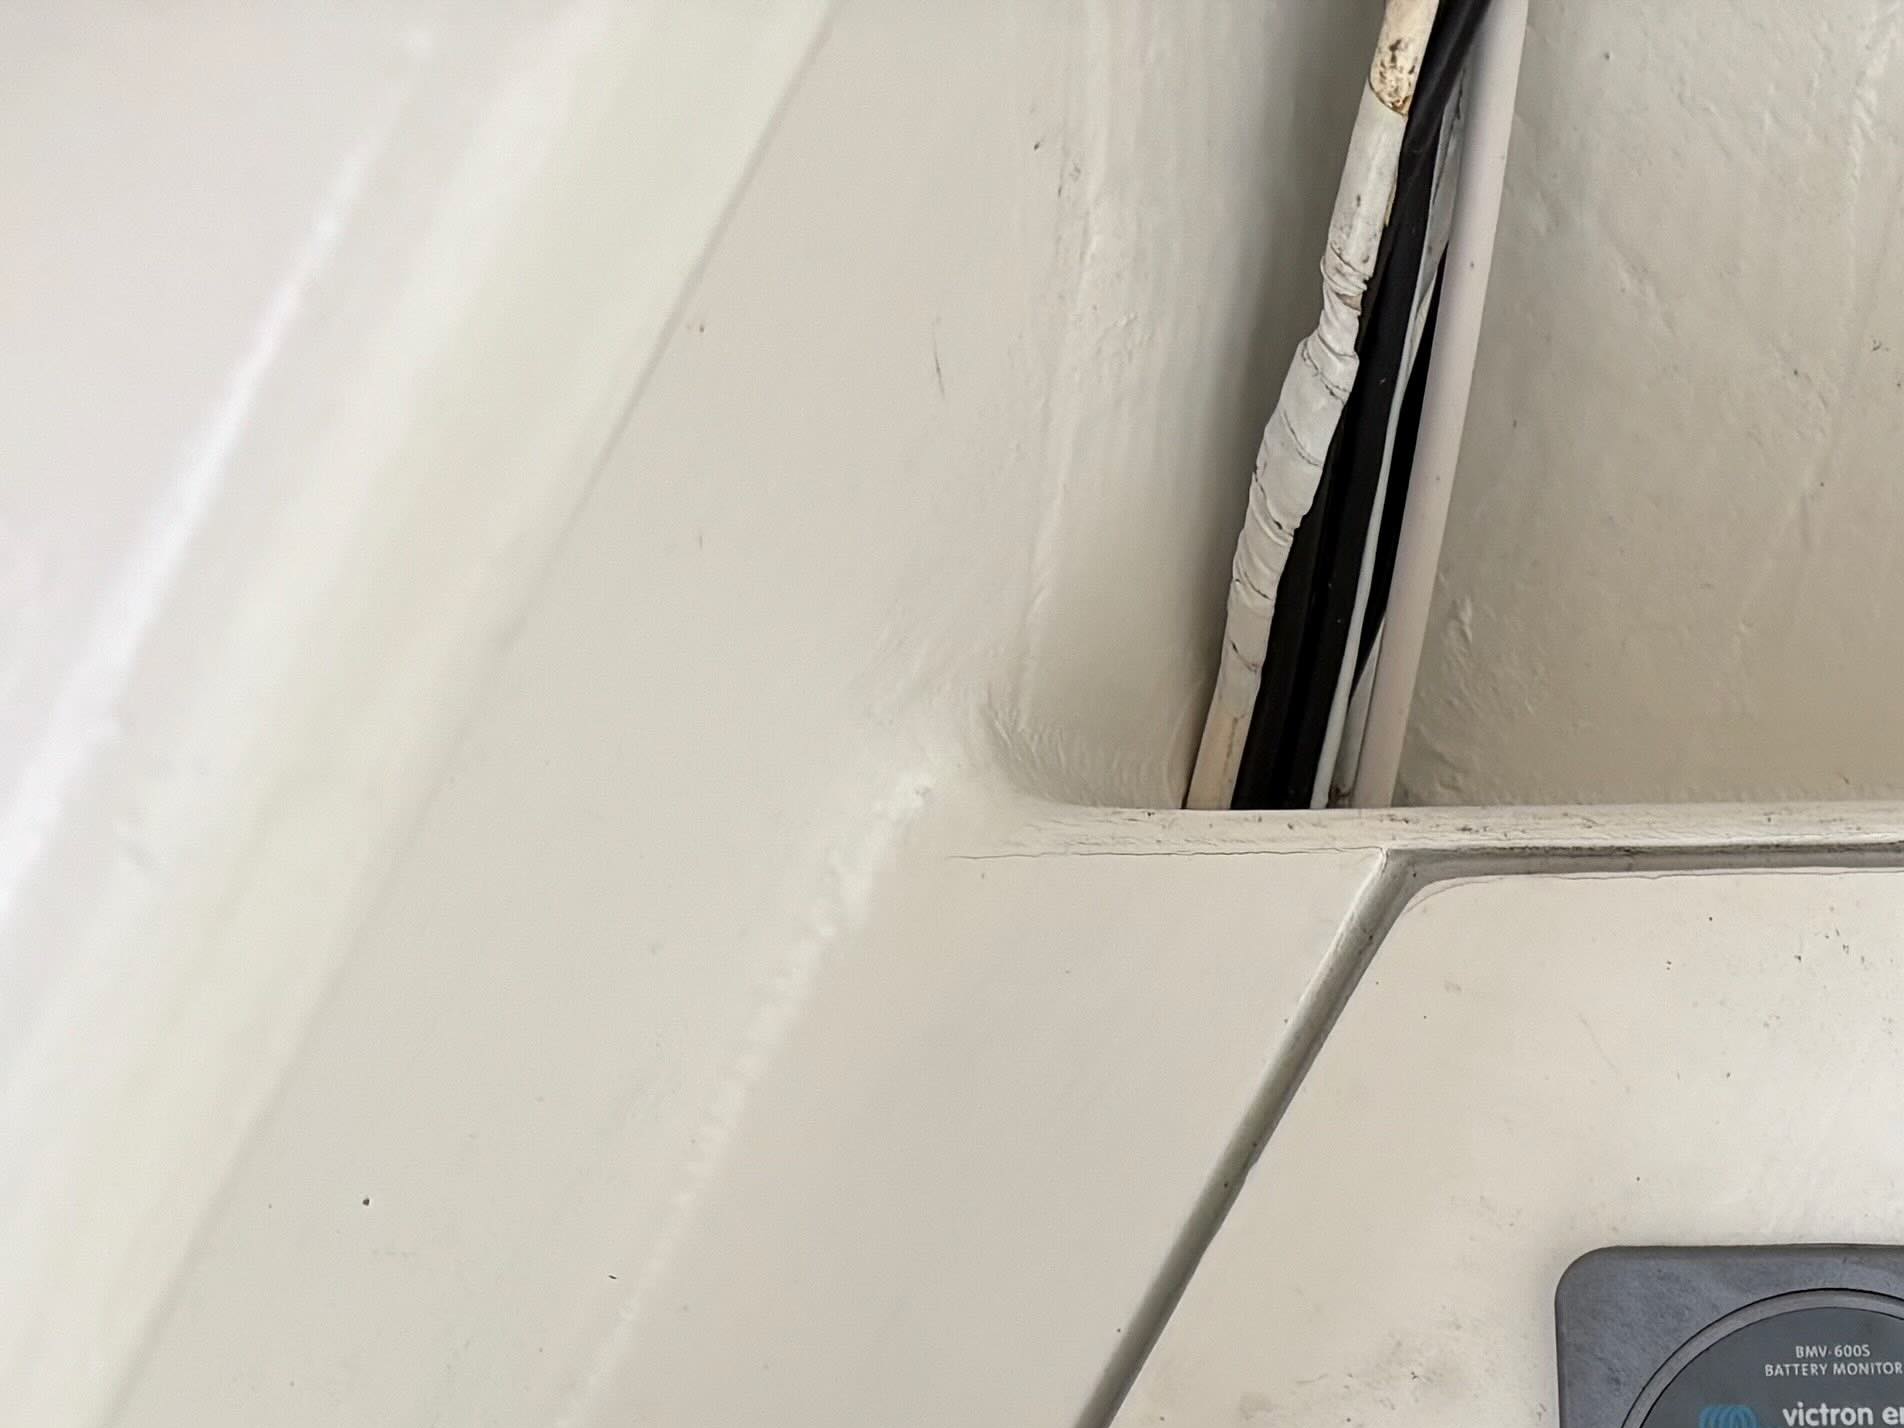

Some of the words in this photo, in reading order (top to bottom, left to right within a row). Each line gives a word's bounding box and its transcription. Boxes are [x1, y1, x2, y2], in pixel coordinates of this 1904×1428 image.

[1764, 1362, 1828, 1377] BATTERY
[1832, 1361, 1903, 1376] MONITOR
[1782, 1401, 1874, 1427] victron
